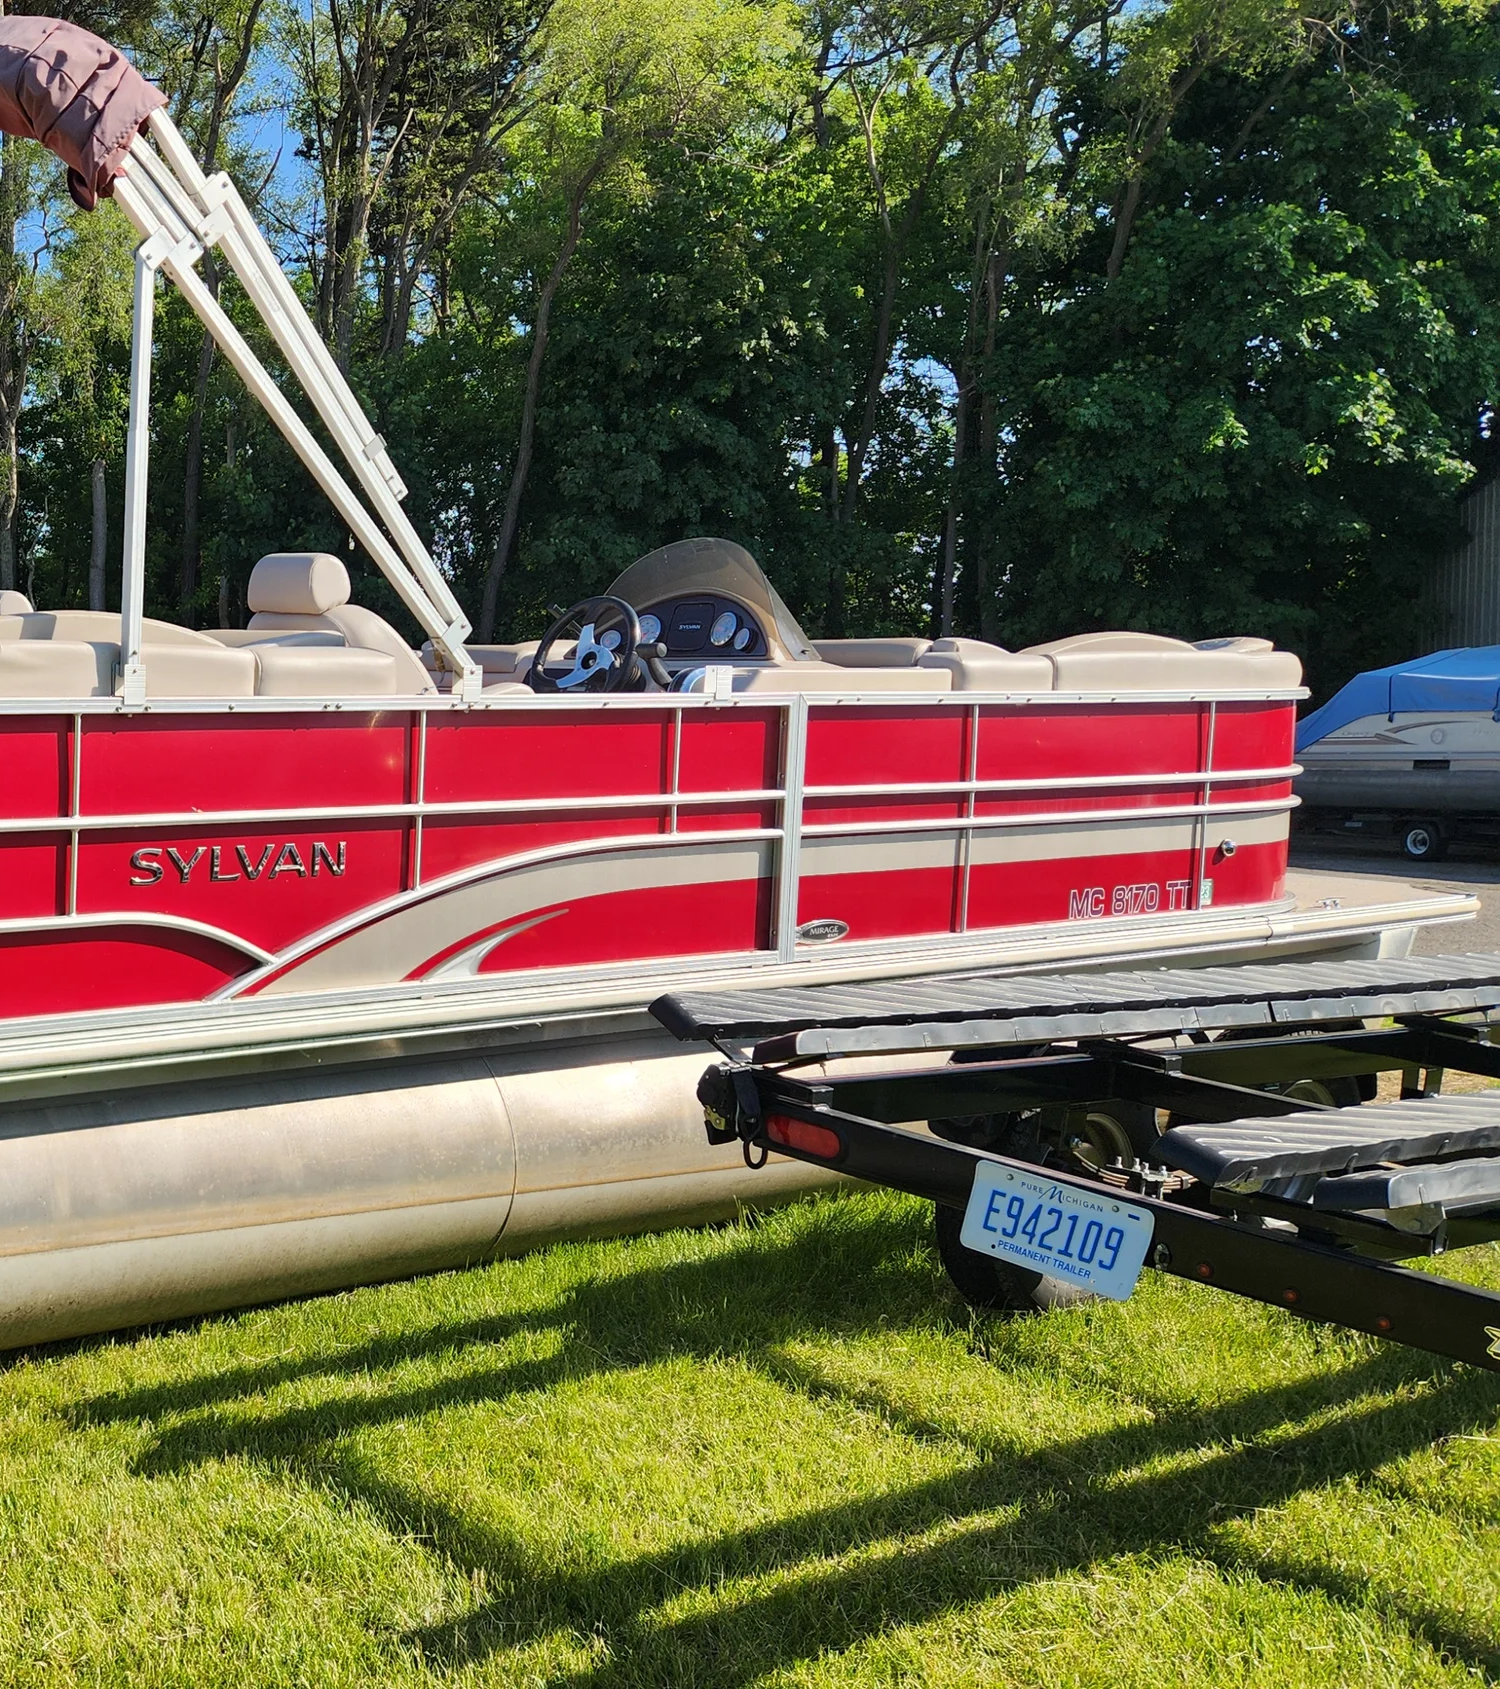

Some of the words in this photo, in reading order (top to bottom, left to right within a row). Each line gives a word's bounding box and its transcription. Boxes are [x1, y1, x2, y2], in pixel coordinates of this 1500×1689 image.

[129, 841, 347, 887] SYLVAN
[1068, 887, 1106, 920] MC
[1111, 882, 1160, 916] 8170
[1165, 879, 1192, 910] TT
[809, 925, 839, 935] MIRAGE
[1020, 1181, 1044, 1194] PURE
[1038, 1185, 1104, 1213] MICHIGAN
[982, 1189, 1125, 1271] E942109
[997, 1239, 1052, 1265] PERMANENT
[1052, 1257, 1092, 1280] TRAILER
